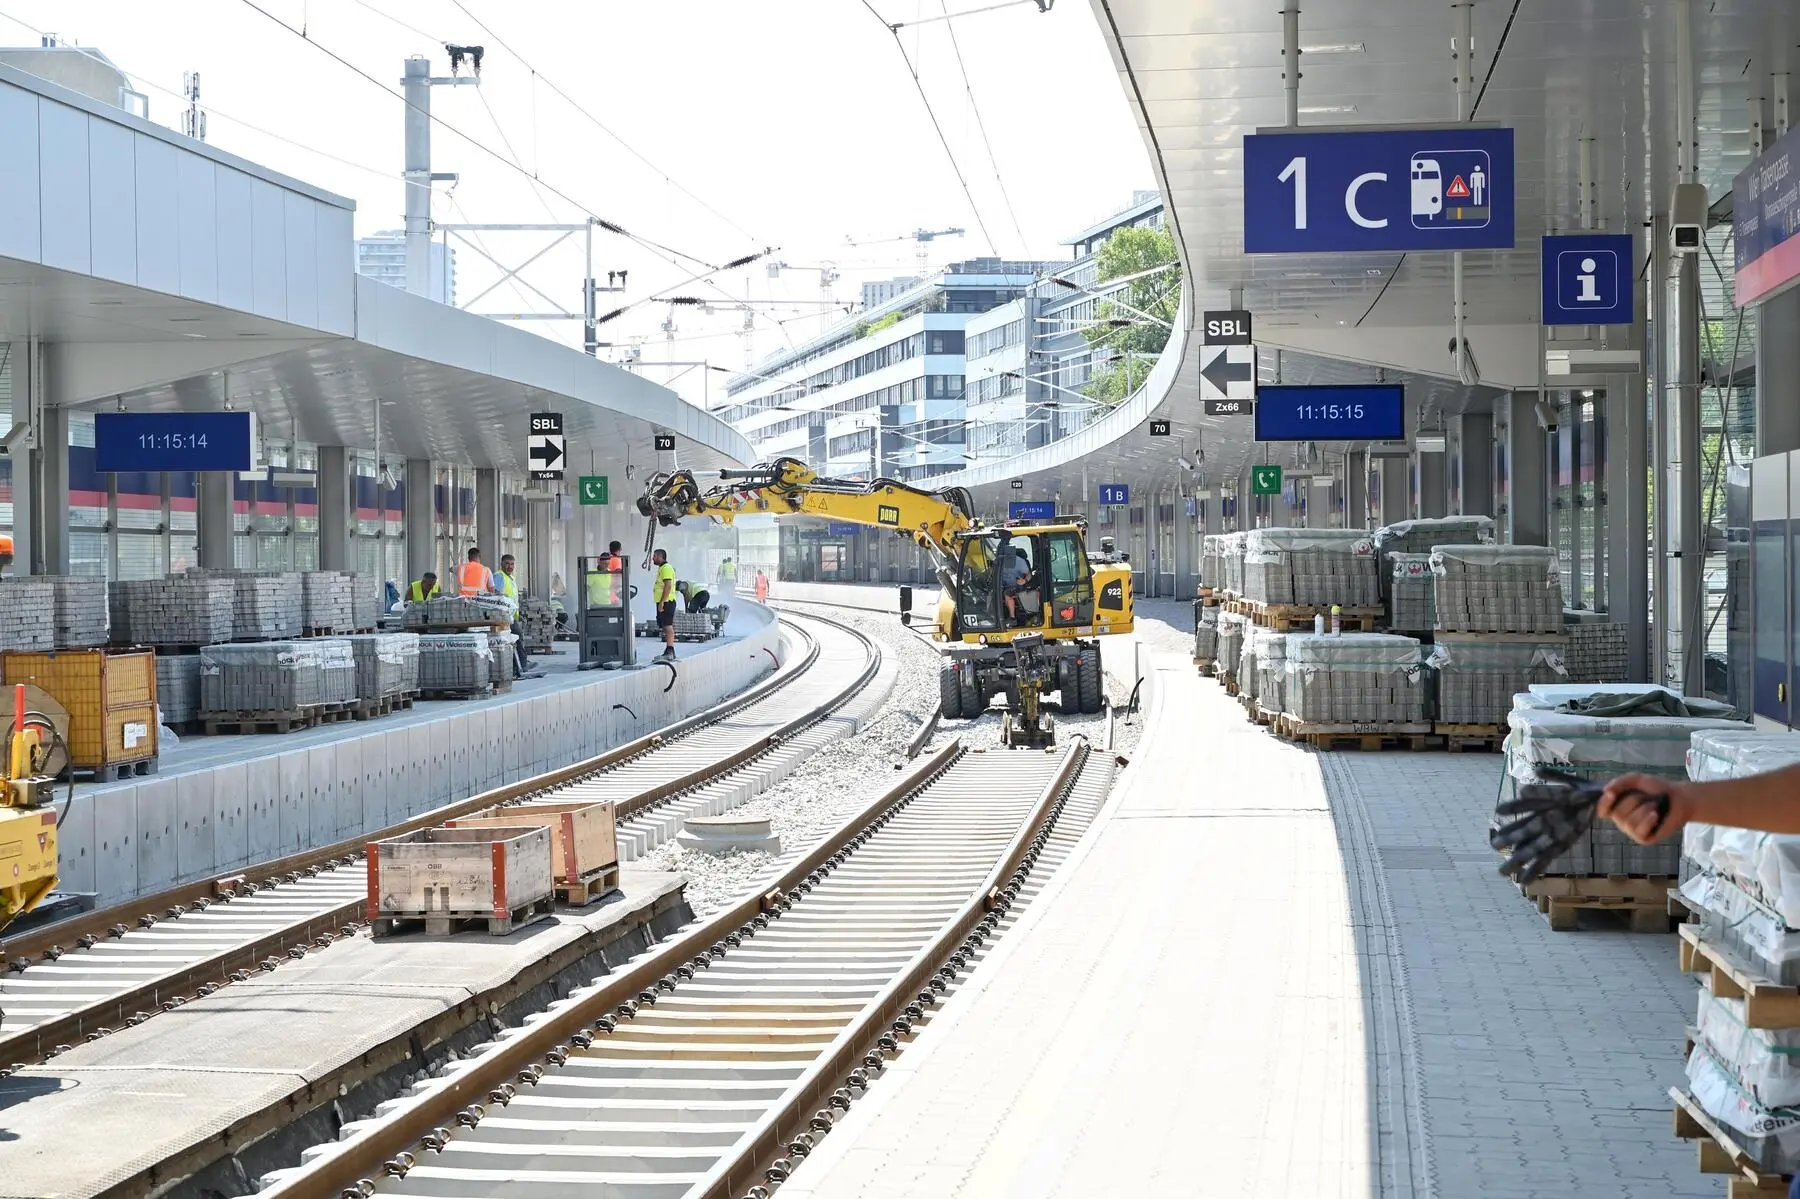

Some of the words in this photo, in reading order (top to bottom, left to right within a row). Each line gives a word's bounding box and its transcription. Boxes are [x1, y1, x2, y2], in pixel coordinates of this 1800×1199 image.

[1277, 156, 1308, 230] 1
[1207, 320, 1248, 336] SBL
[1215, 402, 1240, 412] Zx66
[1296, 404, 1364, 420] 11:15:15
[532, 418, 559, 430] SBL
[1154, 424, 1166, 433] 70
[138, 433, 208, 449] 11:15:14
[659, 438, 671, 448] 70
[1105, 488, 1112, 501] 1
[1116, 491, 1124, 501] B
[1107, 588, 1122, 596] 922
